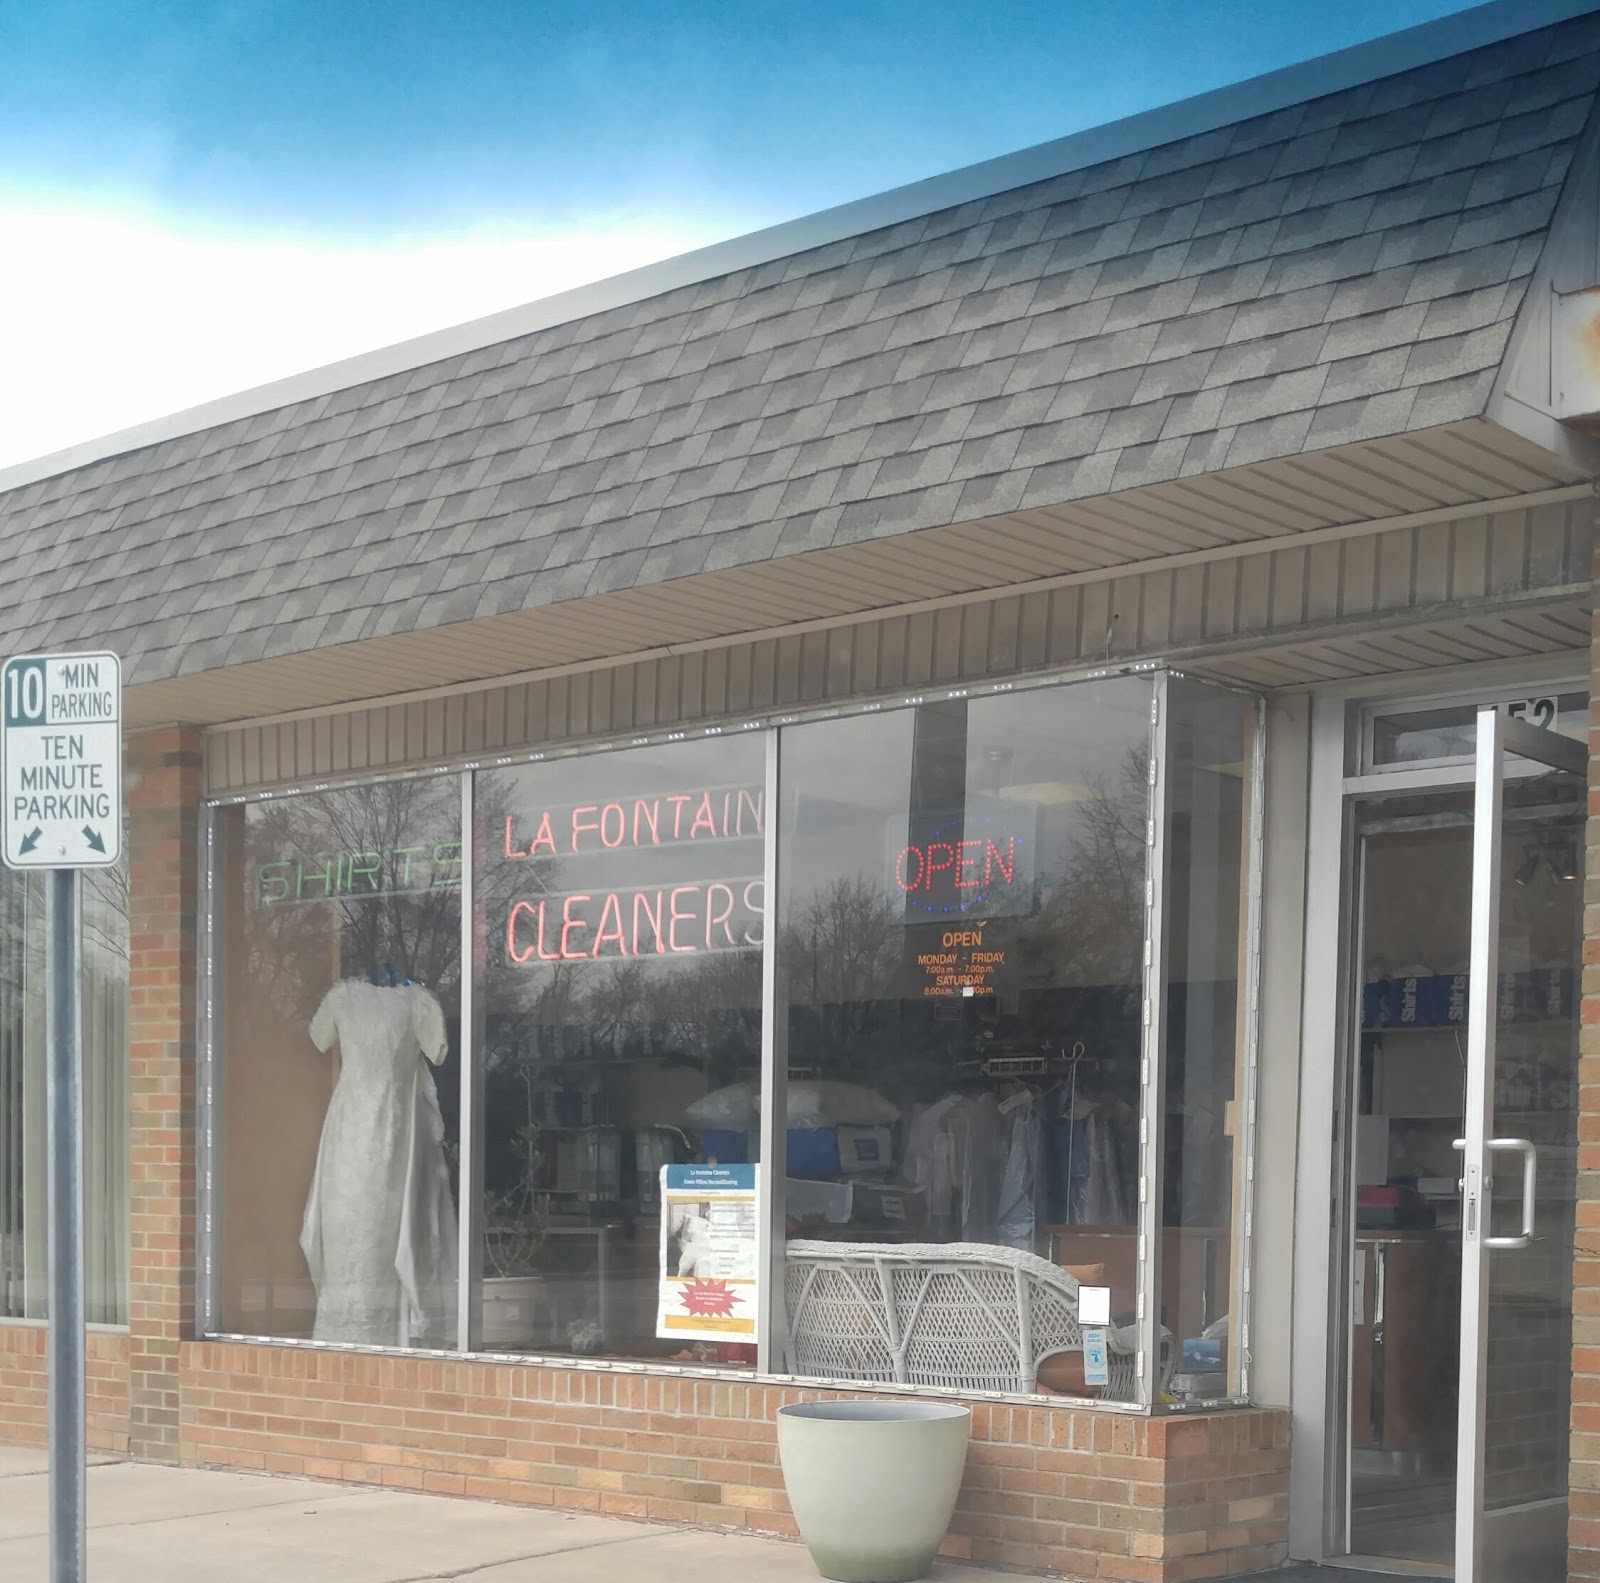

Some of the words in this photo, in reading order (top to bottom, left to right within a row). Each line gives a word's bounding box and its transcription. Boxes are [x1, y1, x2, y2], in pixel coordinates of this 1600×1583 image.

[65, 662, 99, 689] MIN
[8, 666, 44, 719] 10
[51, 691, 112, 718] PARKING
[41, 734, 84, 760] TEN
[20, 763, 103, 791] MINUTE
[14, 793, 110, 821] PARKING
[505, 812, 557, 859] LA
[258, 841, 462, 902] SHIRTS
[896, 836, 1014, 892] OPEN
[507, 880, 764, 963] CLEANERS
[942, 931, 982, 948] OPEN
[918, 953, 958, 965] MONDAY
[971, 951, 1005, 963] FRIDAY
[936, 974, 985, 986] SATURDAY
[1401, 978, 1417, 1022] Shirts
[1449, 975, 1465, 1020] Shirts
